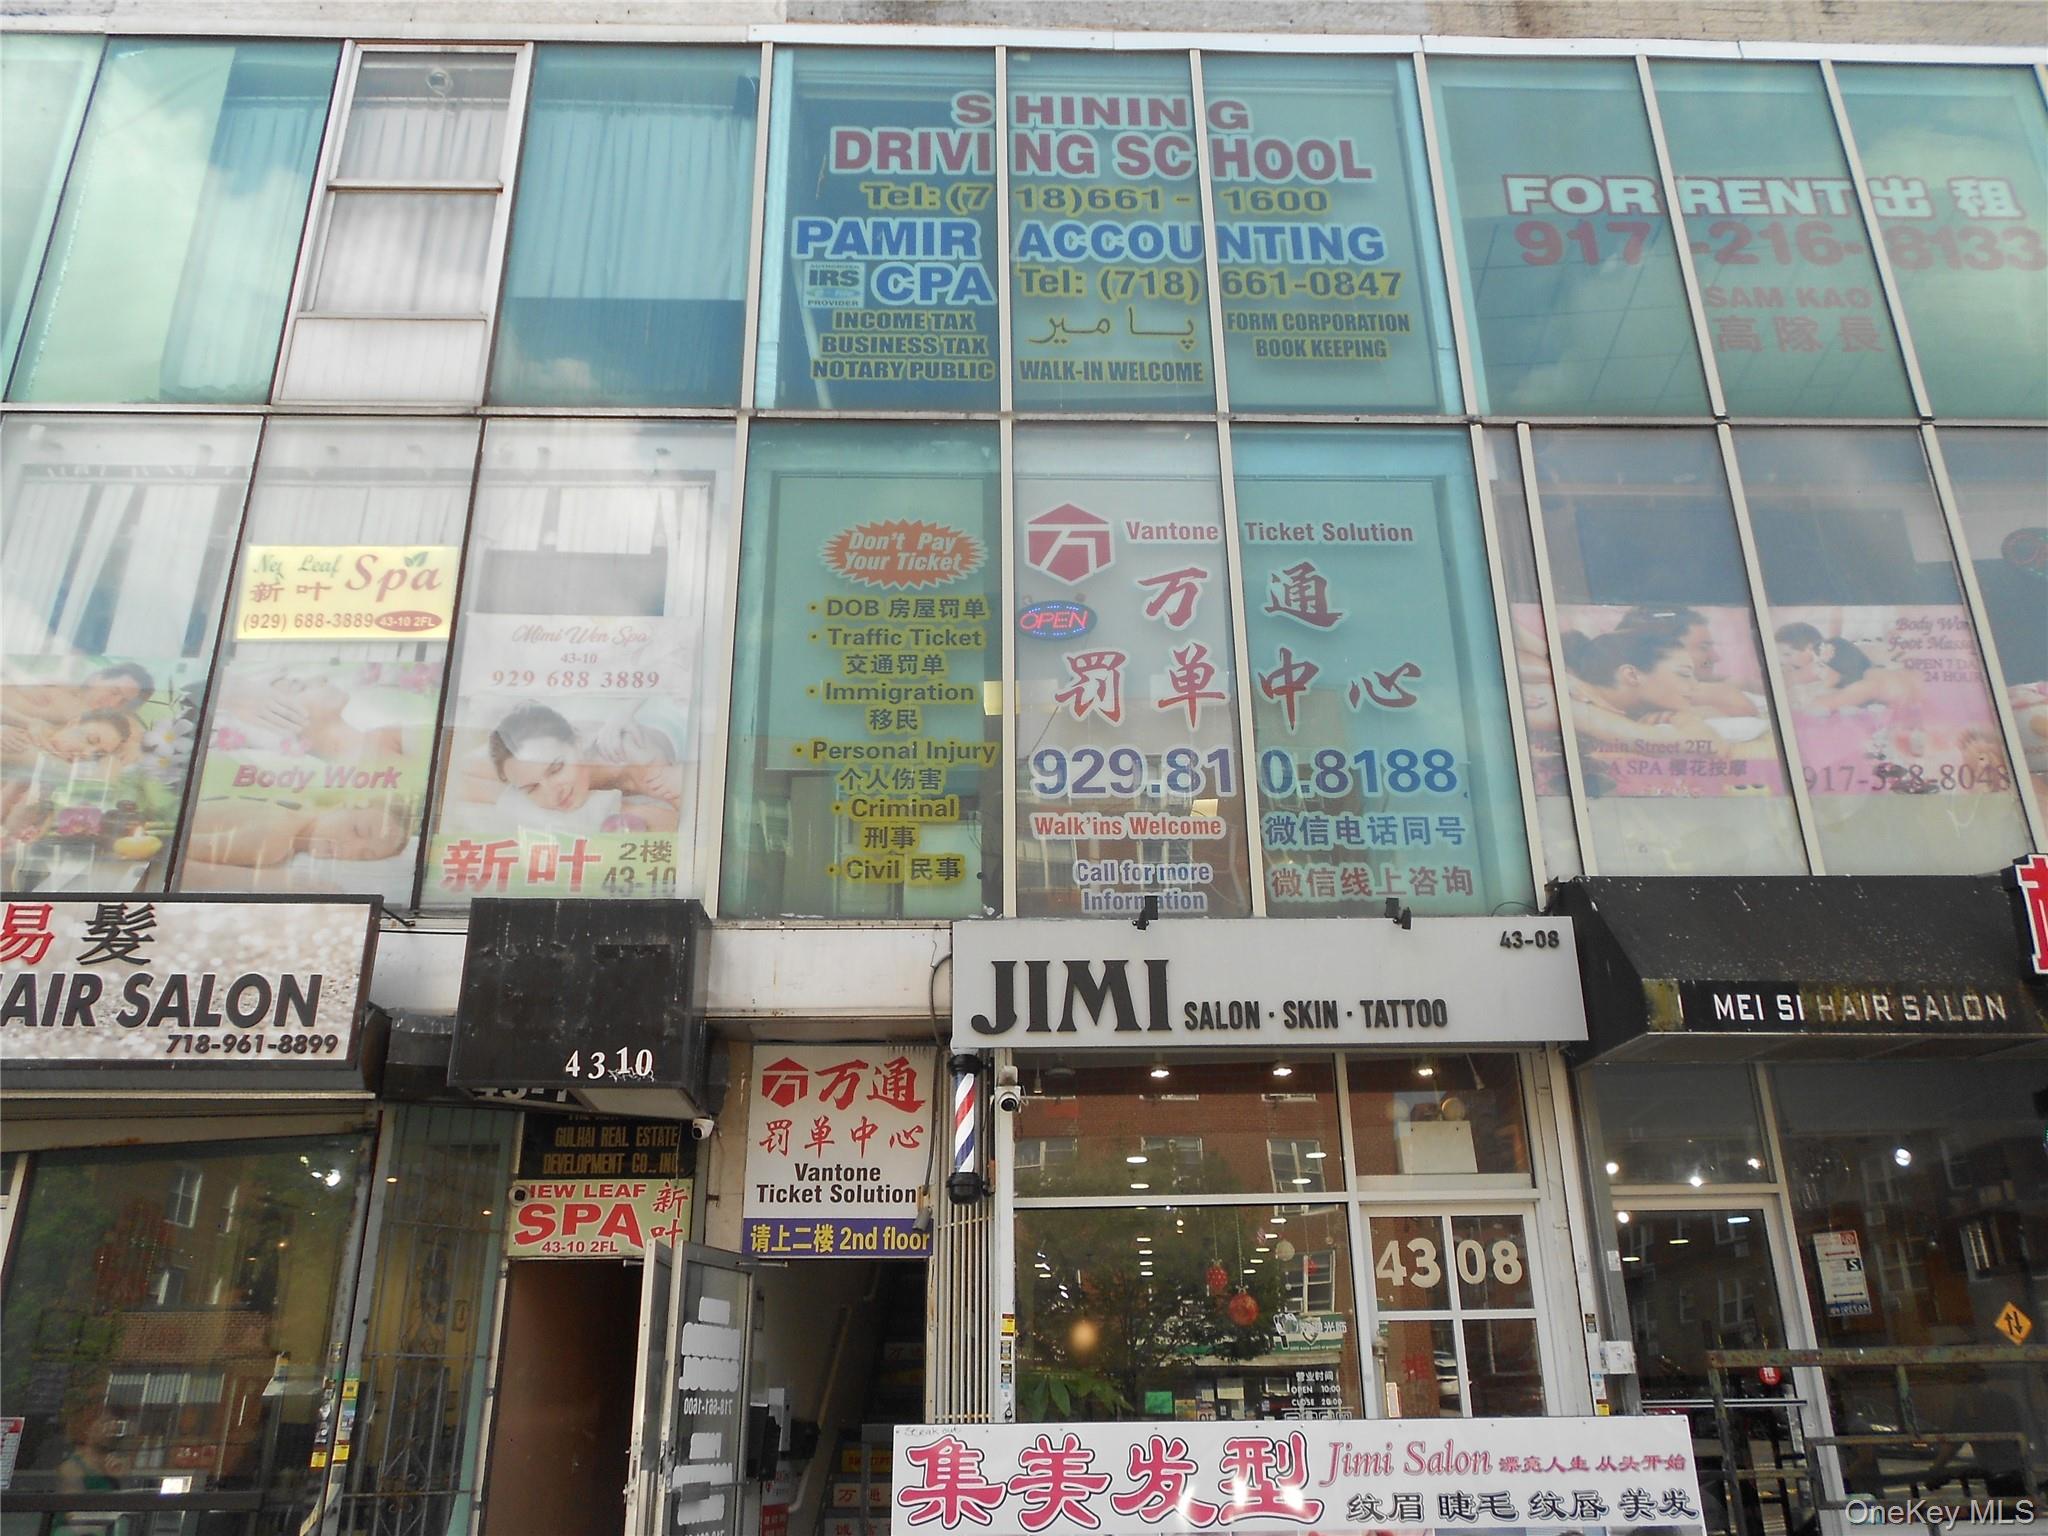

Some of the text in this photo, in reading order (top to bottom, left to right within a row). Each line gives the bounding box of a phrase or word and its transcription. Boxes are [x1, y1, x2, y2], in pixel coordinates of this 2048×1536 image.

[955, 94, 1249, 130] SHINING
[834, 132, 1372, 180] DRIVING SCHOOL
[866, 184, 937, 208] Tel:
[1504, 176, 1854, 217] FOR RENT
[797, 219, 1385, 262] PAMIR ACCOUNTING
[809, 270, 860, 286] IRS
[876, 266, 993, 302] CPA
[1020, 270, 1084, 294] Tel:
[1706, 287, 1872, 308] SAM KAO
[835, 311, 974, 330] INCOME TAX
[1227, 312, 1410, 332] FORM CORPORATION
[822, 336, 986, 354] BUSINESS TAX
[1256, 339, 1387, 358] BOOK KEEPING
[813, 360, 993, 379] NOTARY PUBLIC
[1020, 361, 1203, 382] WALK-IN WELCOME
[848, 532, 957, 553] Don't Pay
[1126, 521, 1414, 542] Vantone Ticket Solution
[844, 552, 962, 571] Your Ticket
[345, 554, 441, 602] Spa
[827, 598, 985, 619] DOB 房屋罚单
[243, 613, 287, 631] (929)
[294, 613, 374, 629] 688-3889
[414, 616, 435, 627] 2FL
[1019, 610, 1088, 632] OPEN
[612, 626, 649, 648] Spa
[828, 628, 982, 646] Traffic Ticket
[846, 654, 944, 676] 交通罚单
[1904, 658, 1942, 670] OPEN
[492, 670, 659, 688] 929 688 3889
[826, 682, 974, 703] Immigration
[869, 708, 918, 730] 移民
[813, 740, 996, 764] Personal Injury
[233, 764, 402, 793] Body Work
[840, 768, 942, 790] 个人伤害
[1627, 761, 1662, 775] SPA
[851, 798, 955, 818] Criminal
[1130, 816, 1222, 836] Welcome
[1265, 816, 1466, 846] 微信电话同号
[864, 826, 915, 849] 刑事
[619, 839, 672, 863] 2楼
[442, 838, 602, 892] 新叶
[846, 858, 961, 881] Civil 民事
[1075, 861, 1115, 882] Call
[602, 866, 676, 897] 43-10
[1271, 865, 1473, 896] 微信线上咨询
[1500, 930, 1560, 949] 43-08
[0, 972, 323, 1028] AIR SALON
[971, 959, 1448, 1035] JIMI SALON SKIN TATTOO
[1714, 993, 2007, 1022] MEI SI HAIR SALON
[165, 1034, 338, 1054] 718-961-8899
[815, 1056, 926, 1113] 万通
[601, 1126, 629, 1147] REAL
[636, 1126, 679, 1147] ESTATE
[759, 1115, 924, 1159] 罚单中心
[543, 1153, 624, 1174] DEVELOPMENT
[795, 1163, 881, 1182] Vantone
[584, 1184, 646, 1198] LEAF
[756, 1184, 916, 1204] Ticket Solution
[514, 1203, 644, 1248] SPA
[542, 1241, 619, 1253] 43-10 2FL
[751, 1224, 930, 1253] 请上二楼 2nd floor
[1291, 1386, 1313, 1394] OPEN
[1292, 1398, 1314, 1406] CLOSE
[1319, 1439, 1686, 1487] Jimi Salon 漂亮人生 从头开始
[899, 1431, 1321, 1530] 集美发型
[1346, 1489, 1699, 1522] 纹眉 睫毛 纹唇 美发
